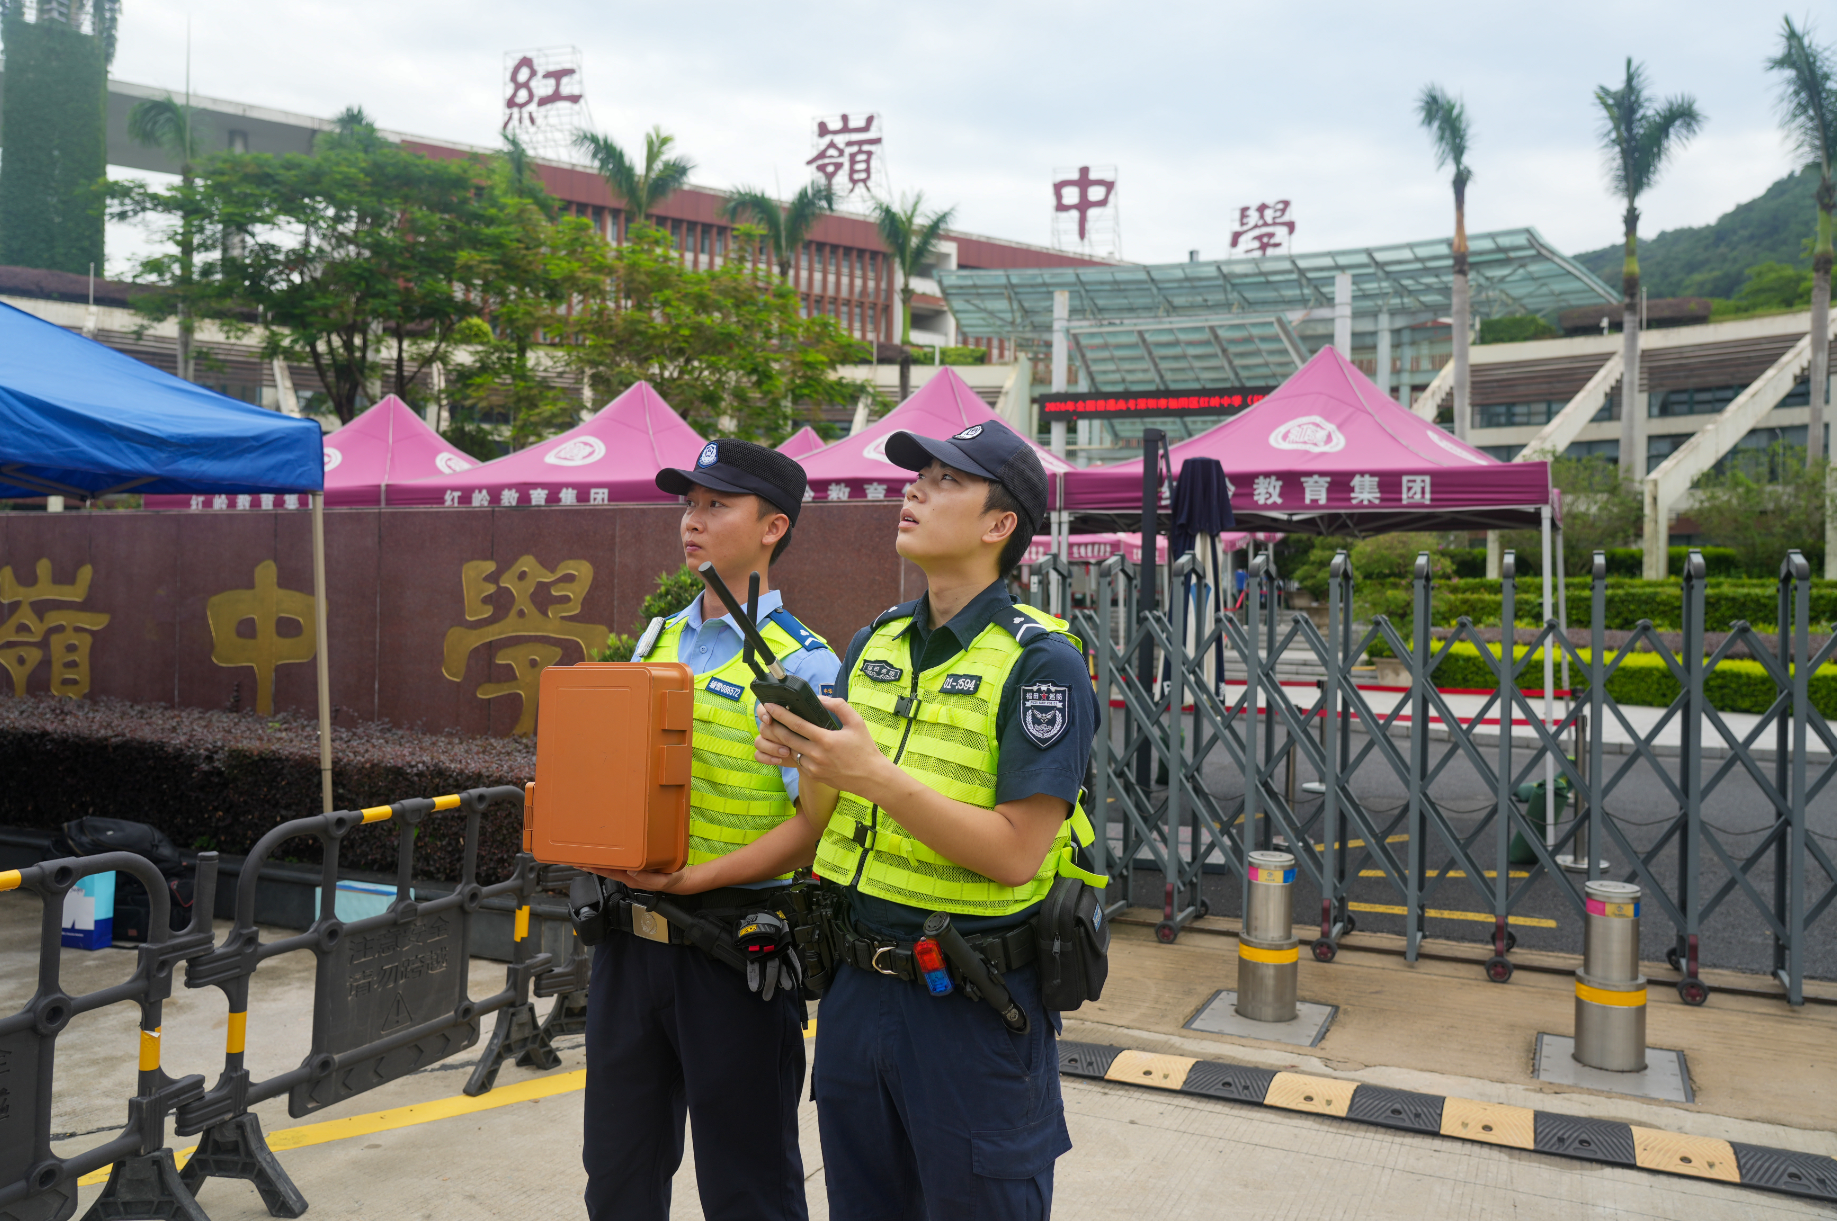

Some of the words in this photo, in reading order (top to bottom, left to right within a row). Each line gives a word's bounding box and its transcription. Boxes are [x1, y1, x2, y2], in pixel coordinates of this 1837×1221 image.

[444, 488, 609, 506] 红岭教育集团
[348, 916, 450, 967] 注意安全
[346, 946, 450, 1000] 请勿跨越
